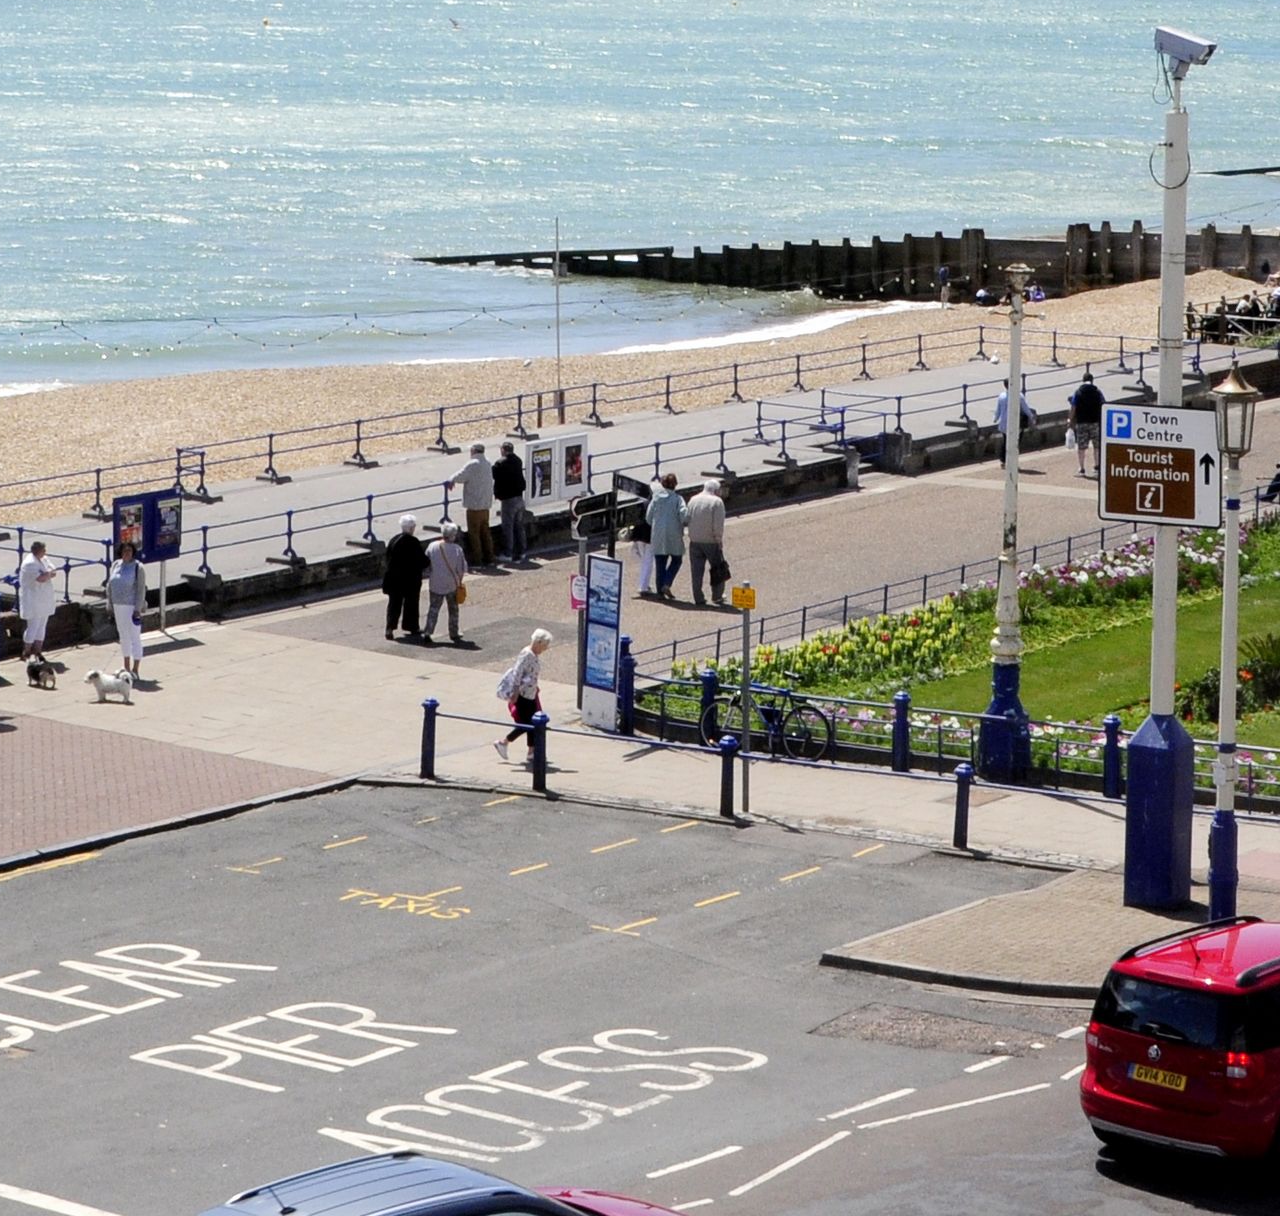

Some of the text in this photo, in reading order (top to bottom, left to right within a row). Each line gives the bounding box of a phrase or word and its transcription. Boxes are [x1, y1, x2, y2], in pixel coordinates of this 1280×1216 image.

[1112, 413, 1128, 436] P
[1142, 412, 1179, 426] Town
[1136, 428, 1184, 443] Centre
[1127, 449, 1174, 465] Tourist
[1111, 464, 1190, 483] Information
[128, 1001, 458, 1093] PIER
[1136, 1066, 1159, 1082] GV14
[317, 1028, 769, 1163] ACCESS
